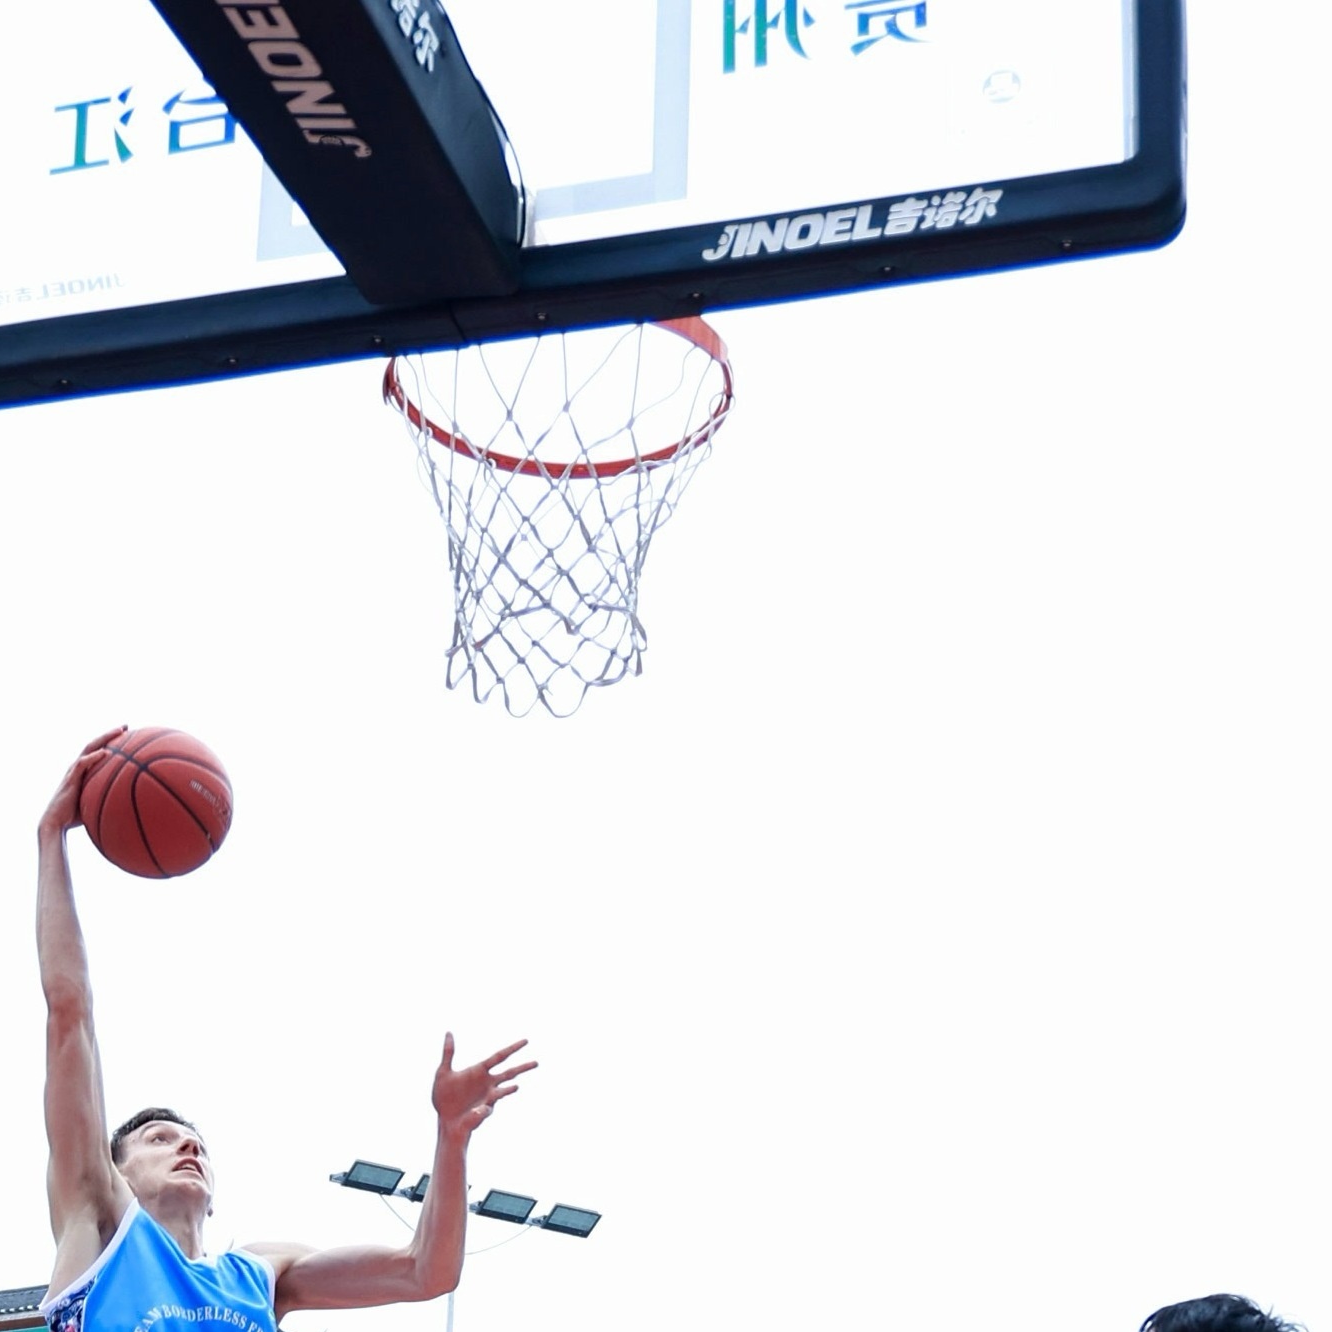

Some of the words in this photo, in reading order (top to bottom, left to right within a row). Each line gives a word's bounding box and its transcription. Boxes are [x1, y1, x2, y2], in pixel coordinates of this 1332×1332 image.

[216, 0, 372, 159] JINOE
[702, 204, 883, 261] JINOEL
[883, 187, 1004, 237] 吉诺尔
